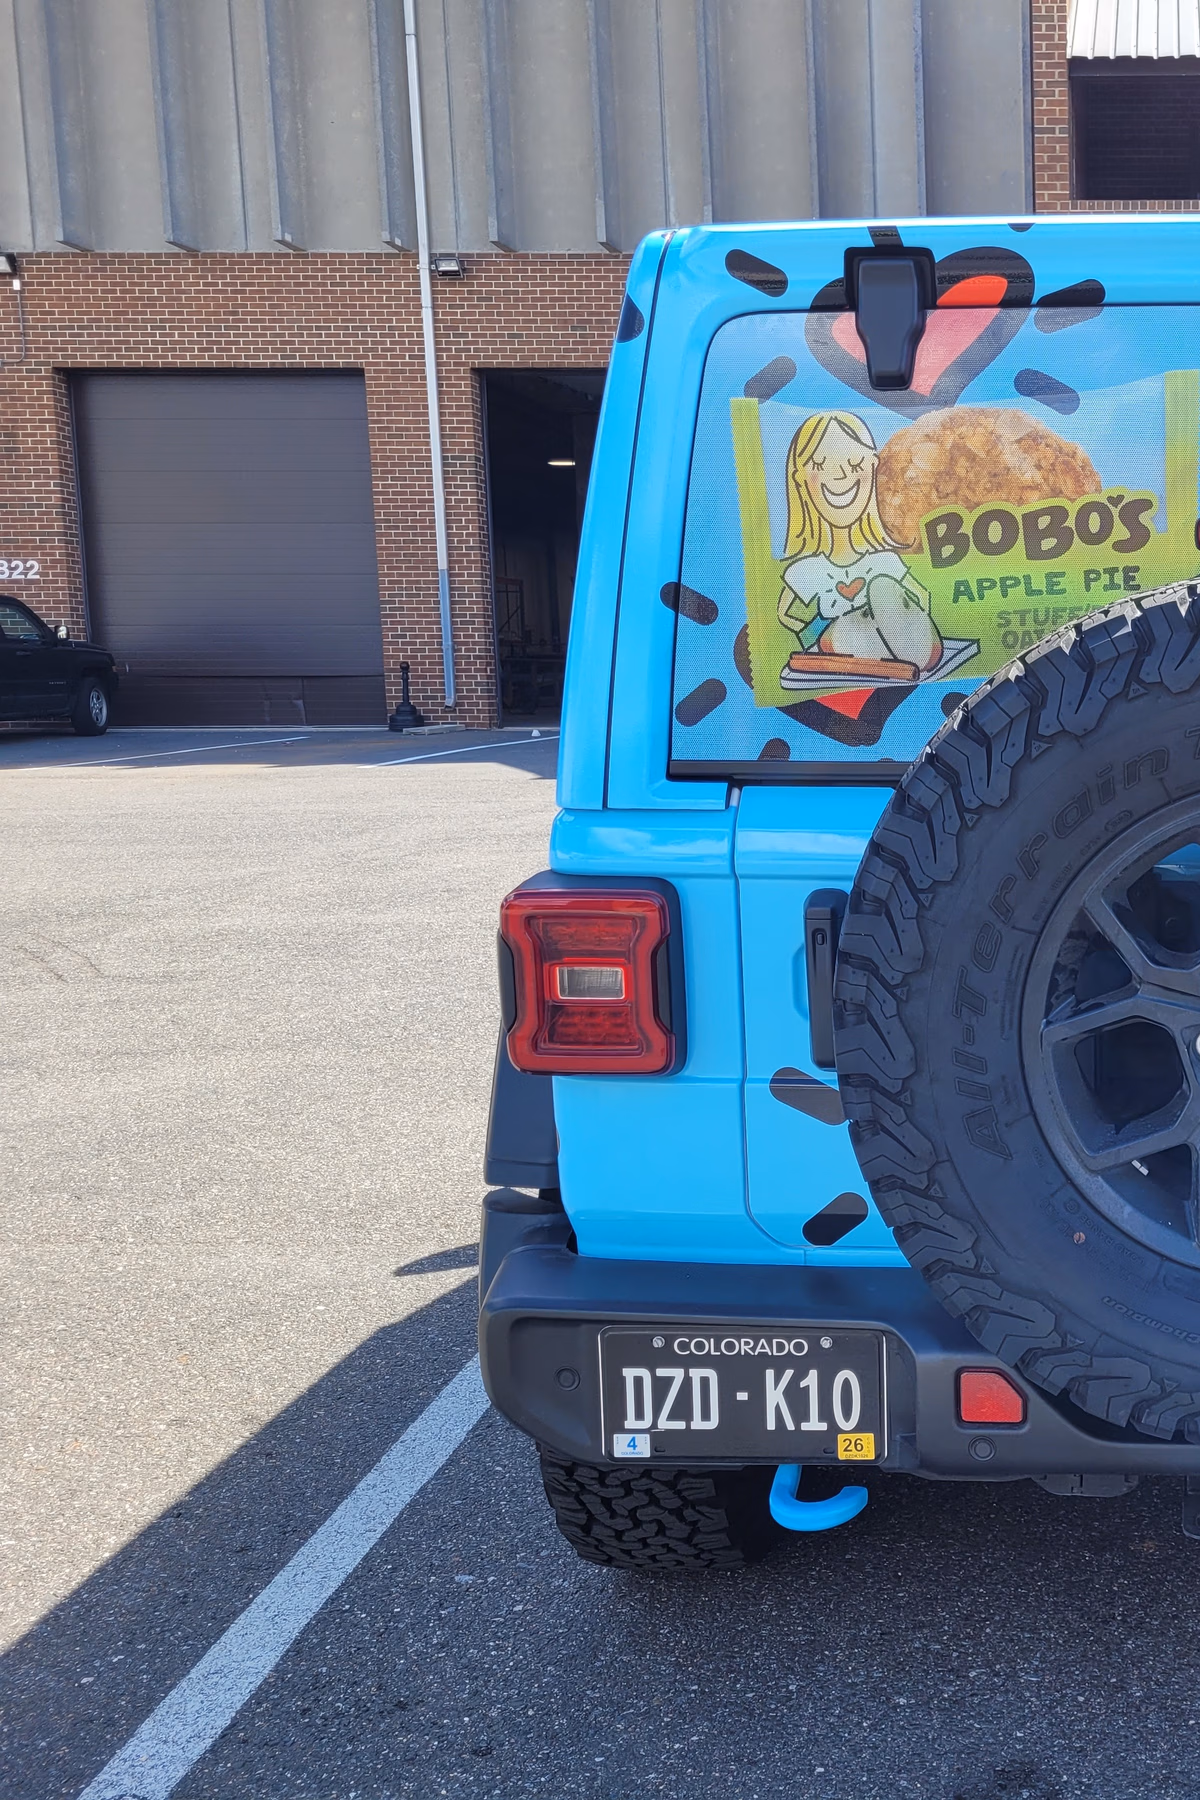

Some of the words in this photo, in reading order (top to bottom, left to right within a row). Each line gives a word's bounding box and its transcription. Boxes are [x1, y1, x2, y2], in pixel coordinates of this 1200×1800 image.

[924, 494, 1154, 569] BOBO'S
[952, 571, 1067, 604] APPLE
[1083, 565, 1141, 592] PIE
[997, 603, 1104, 628] STUFF'
[952, 746, 1170, 1160] All-Terrain
[673, 1337, 809, 1356] COLORADO
[622, 1368, 719, 1430] DZD
[765, 1369, 861, 1431] K10
[626, 1436, 638, 1451] 4
[842, 1437, 863, 1452] 26
